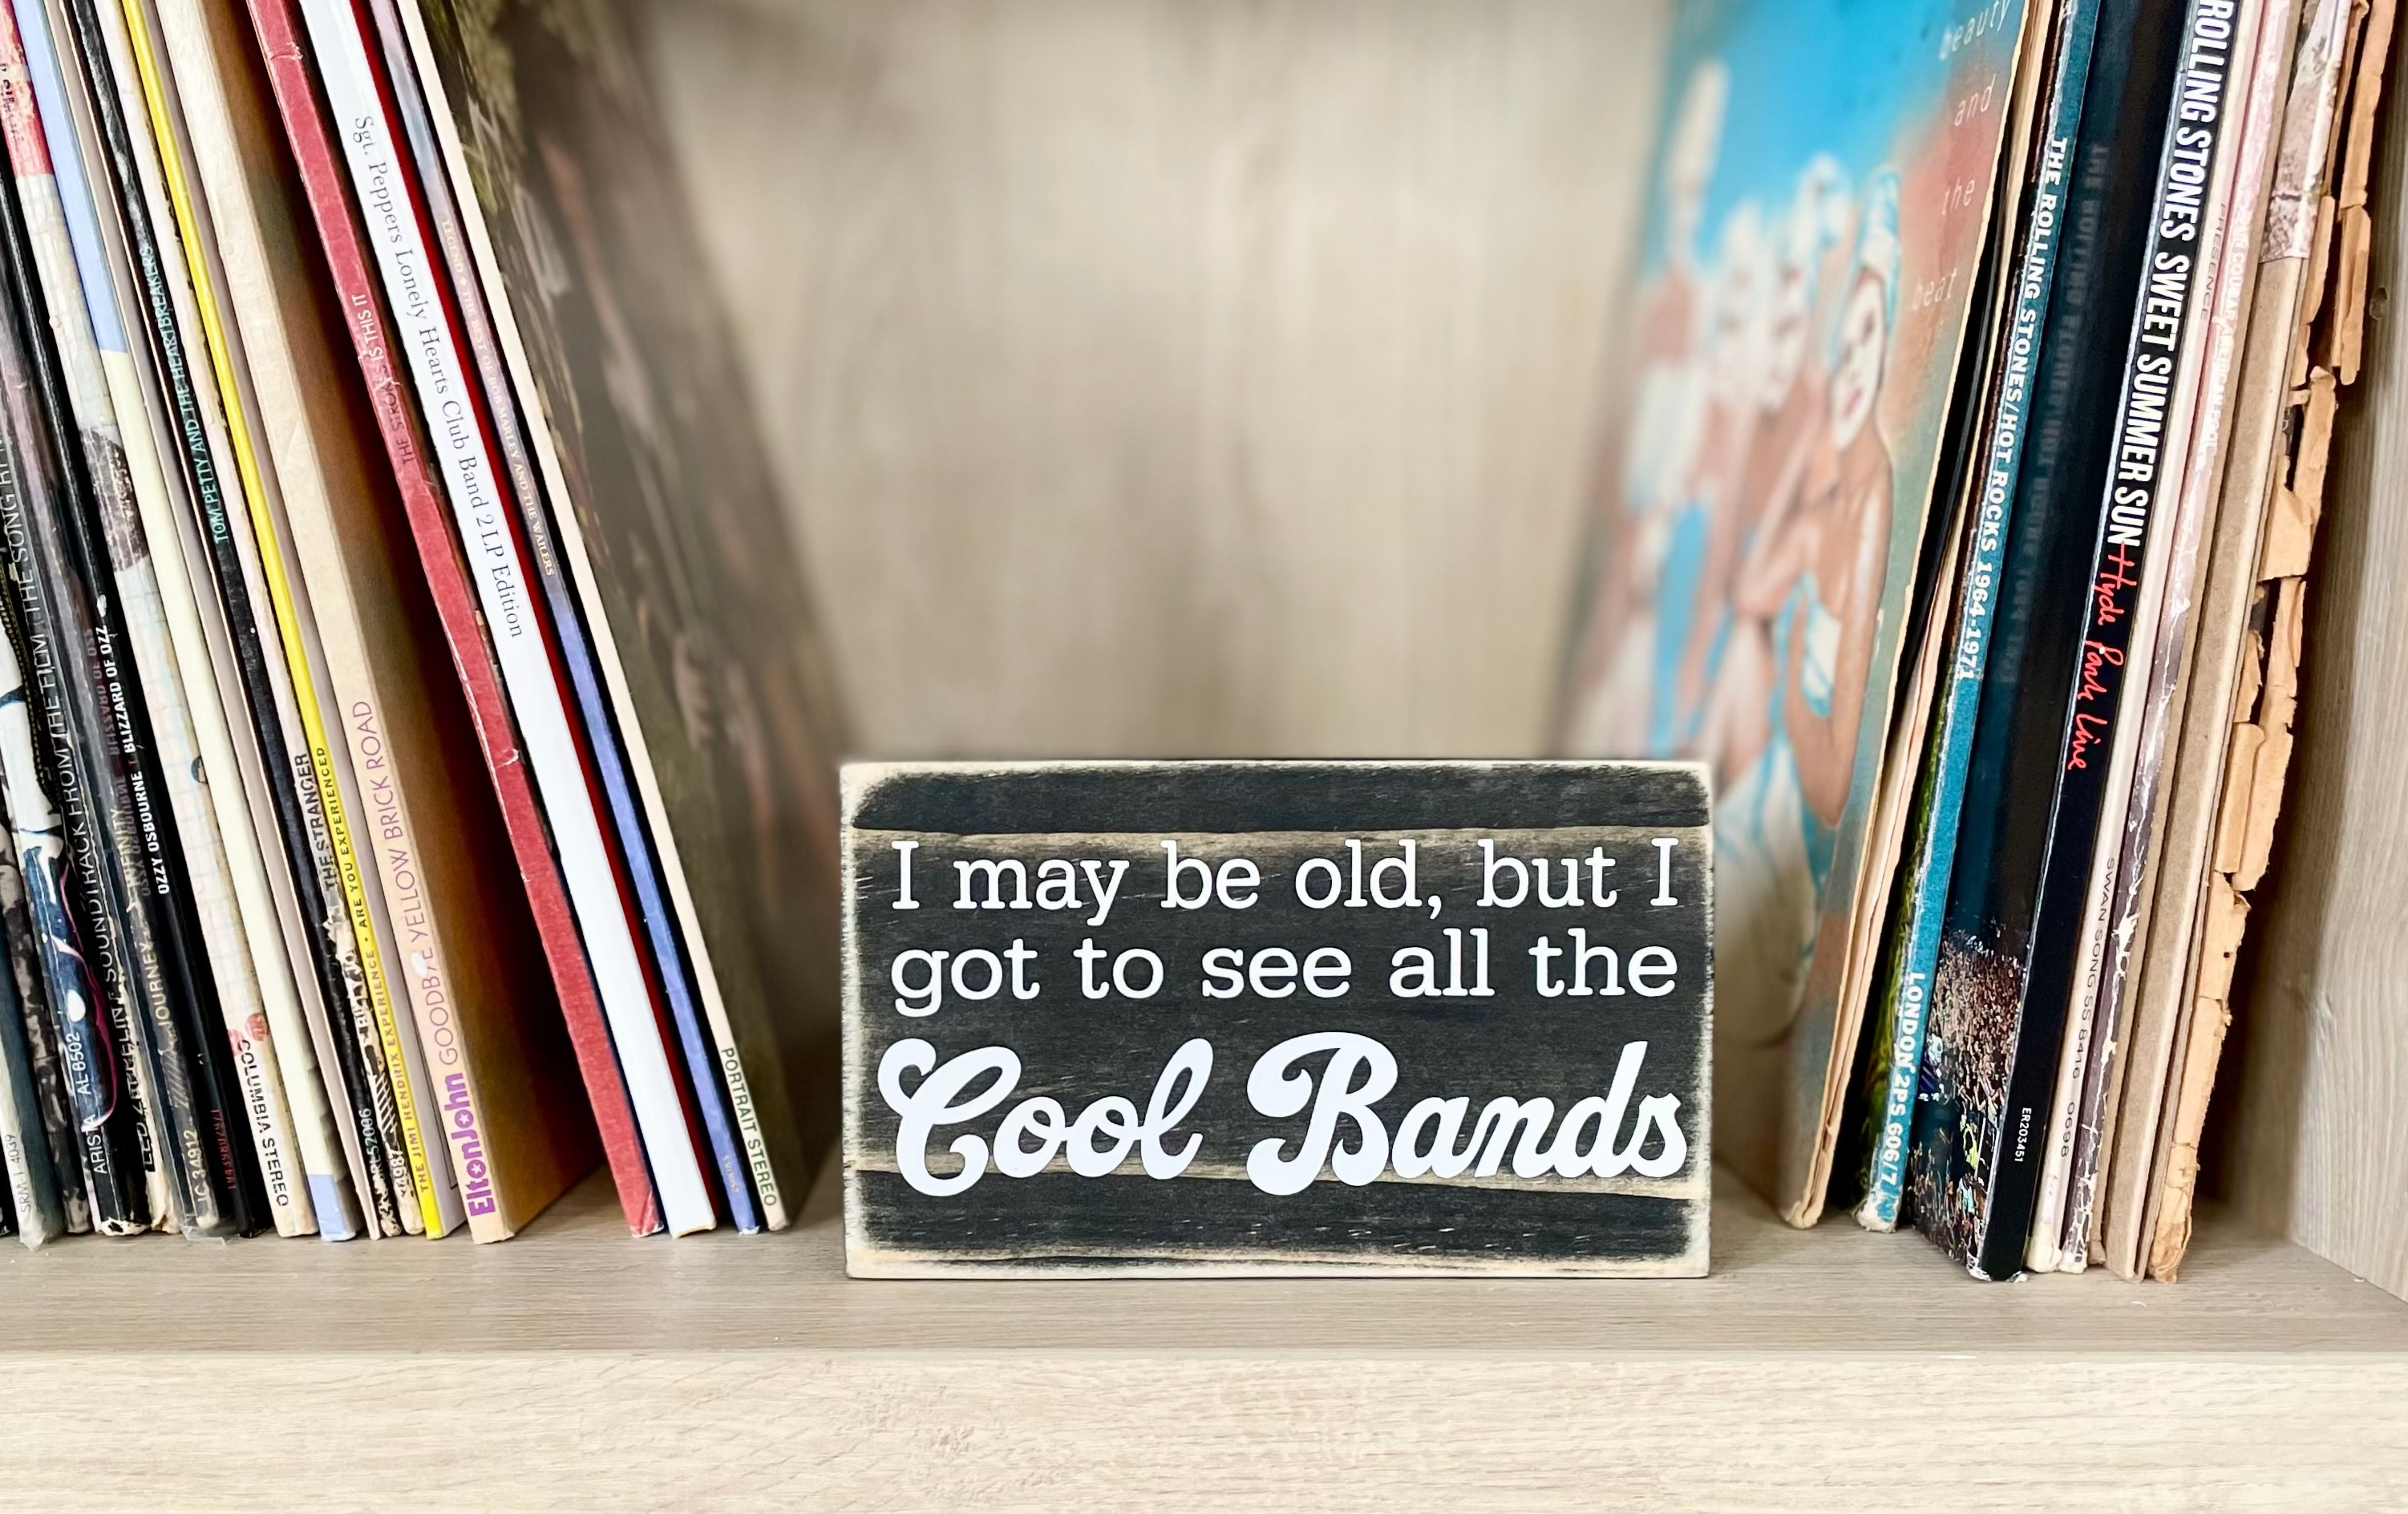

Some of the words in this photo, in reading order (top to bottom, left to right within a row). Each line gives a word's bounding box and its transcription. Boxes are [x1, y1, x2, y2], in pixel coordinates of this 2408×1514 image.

[1939, 0, 2009, 61] beauty
[2177, 0, 2236, 124] ROLLING
[1955, 74, 1997, 126] and
[349, 113, 382, 157] Sgt.
[2042, 136, 2069, 186] THE
[360, 159, 409, 245] Peppers
[1942, 176, 1975, 215] the
[2157, 123, 2214, 242] STONES
[439, 219, 464, 274] LEGEND
[2022, 192, 2058, 301] ROLLING
[2199, 203, 2227, 321] PRESENCE
[137, 244, 186, 380] HEARTBREAKERS
[350, 290, 368, 307] IT
[387, 247, 433, 323] Lonely
[460, 289, 478, 317] THE
[2139, 250, 2191, 348] SWEET
[356, 307, 378, 344] THIS
[366, 344, 385, 362] IS
[469, 318, 488, 353] BEST
[415, 325, 455, 396] Hearts
[480, 354, 495, 374] OF
[486, 374, 504, 404] BOB
[172, 383, 196, 416] THE
[438, 398, 472, 451] Club
[2115, 352, 2174, 484] SUMMER
[181, 417, 205, 455] AND
[395, 435, 416, 465] THE
[495, 405, 520, 459] MARLEY
[192, 455, 219, 504] PETTY
[455, 454, 489, 511] Band
[512, 462, 529, 491] AND
[0, 492, 30, 564] SONG
[205, 504, 229, 544] TOM
[521, 492, 538, 520] THE
[1978, 469, 2010, 553] ROCKS
[2103, 485, 2150, 548] SUN
[529, 520, 556, 577] WAILERS
[16, 569, 41, 616] THE
[488, 562, 529, 638] Edition
[2094, 544, 2137, 625] Hyde
[94, 624, 112, 655] OZZ
[1955, 560, 1994, 682] 1964-1971
[29, 632, 57, 690] FILM
[102, 657, 118, 678] OF
[2078, 640, 2124, 700] Park
[43, 694, 70, 751] THE
[107, 680, 137, 754] BLIZZARD
[350, 698, 386, 771] ROAD
[54, 747, 83, 817] FROM
[129, 770, 161, 852] OSBOURNE
[293, 752, 329, 852] STRANGER
[314, 746, 350, 856] EXPERIENCED
[368, 774, 404, 840] BRICK
[71, 820, 119, 983] SOUNDTRACK
[150, 855, 171, 895] OZZY
[317, 854, 339, 891] THE
[342, 860, 358, 893] YOU
[386, 844, 430, 943] YELLOW
[892, 840, 919, 909] I
[953, 858, 1130, 925] may
[1161, 840, 1260, 909] be
[1295, 840, 1443, 919] old,
[1477, 839, 1617, 909] but
[1649, 838, 1678, 907] I
[2097, 856, 2115, 922] SWAN
[350, 896, 367, 929] ARE
[891, 937, 1039, 1017] got
[1074, 938, 1164, 999] to
[1201, 945, 1352, 998] see
[1389, 929, 1493, 998] all
[1529, 929, 1677, 998] the
[2086, 929, 2103, 988] SONG
[362, 949, 395, 1047] EXPERIENCE
[1895, 970, 1926, 1071] LONDON
[2080, 994, 2094, 1021] SS
[2070, 1027, 2087, 1079] 8416
[387, 1052, 414, 1121] HENDRIX
[877, 1038, 1214, 1196] Cool
[1246, 1032, 1687, 1196] Bands
[1889, 1072, 1911, 1117] 2PS
[82, 1113, 108, 1176] ARISTA
[237, 1038, 272, 1134] COLUMBIA
[261, 1136, 289, 1207] STEREO
[405, 1126, 423, 1159] JIMI
[718, 1046, 758, 1135] PORTRAIT
[746, 1137, 778, 1208] STEREO
[2013, 1106, 2032, 1163] ER203451
[181, 1126, 207, 1180] 34912
[414, 1161, 431, 1192] THE
[1880, 1121, 1904, 1185] 606/7
